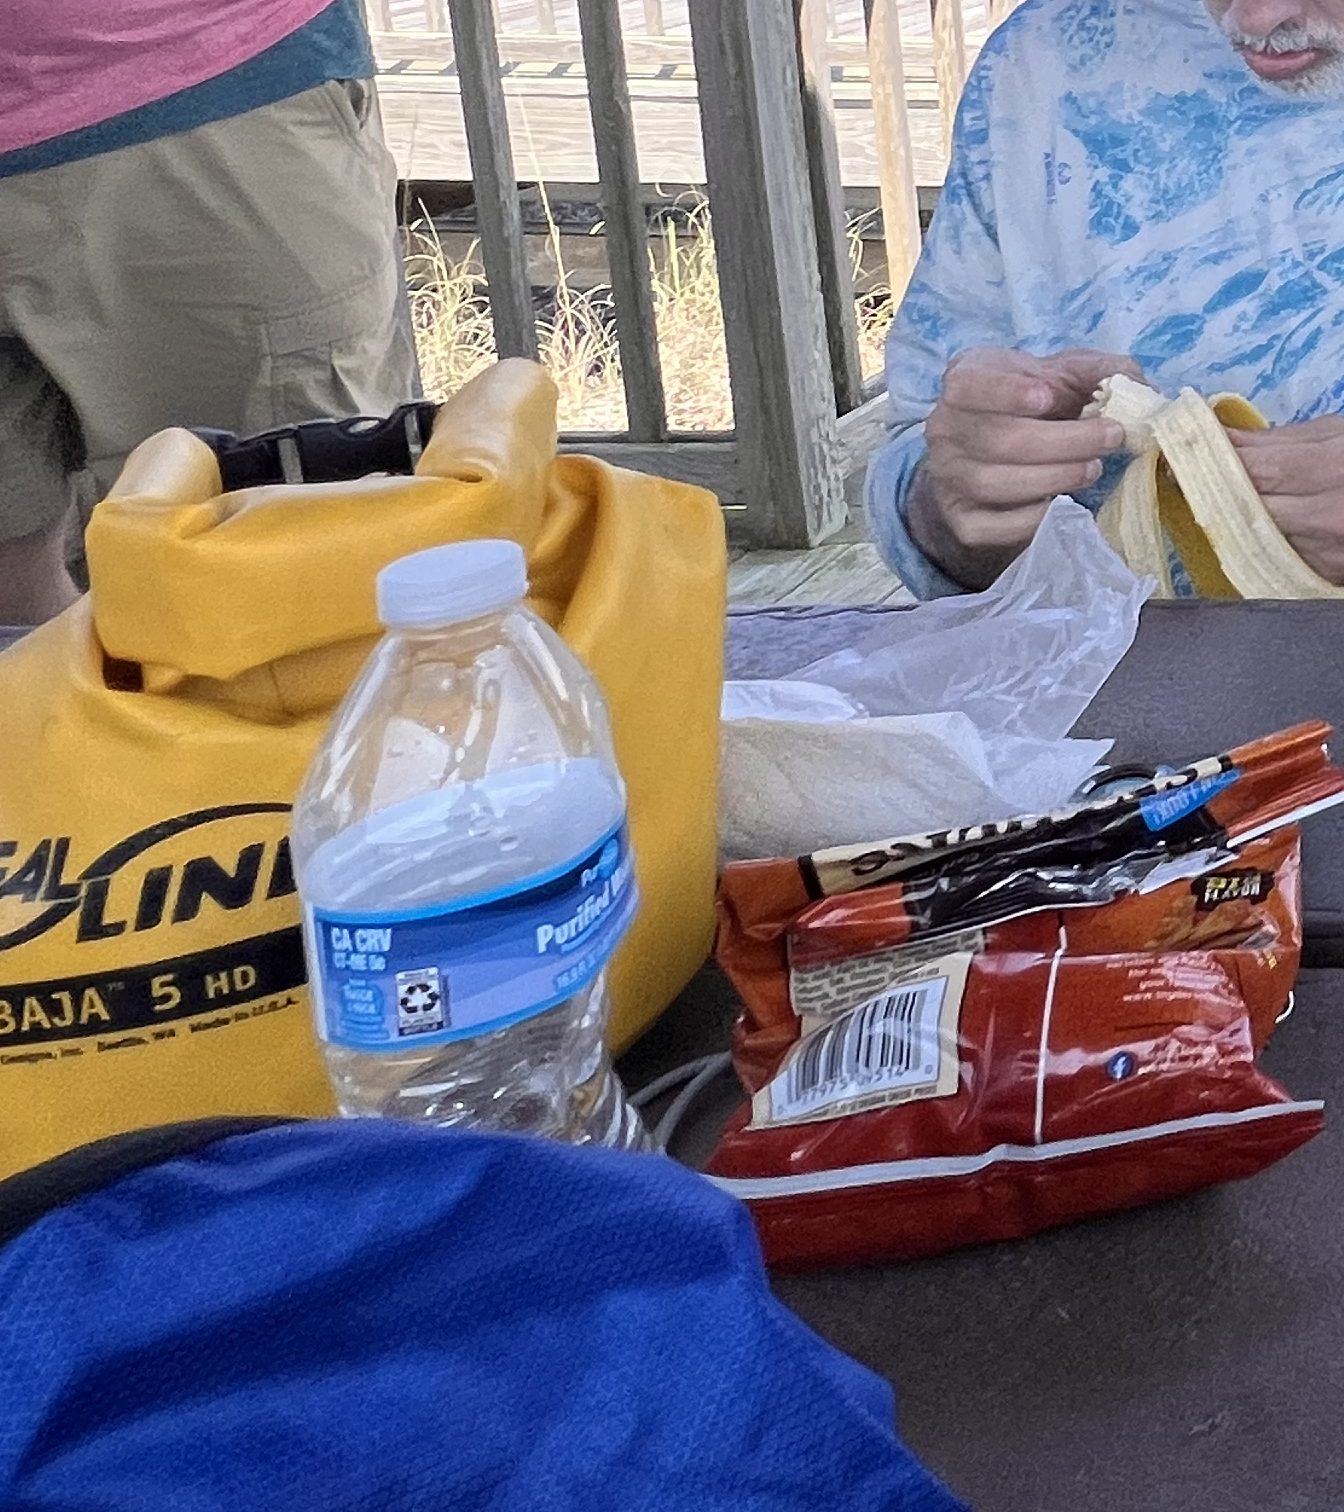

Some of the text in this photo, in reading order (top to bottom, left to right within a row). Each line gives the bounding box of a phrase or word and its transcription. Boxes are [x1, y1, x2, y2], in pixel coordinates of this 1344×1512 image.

[536, 880, 610, 954] Purified
[0, 965, 257, 1035] BAJA 5 HD
